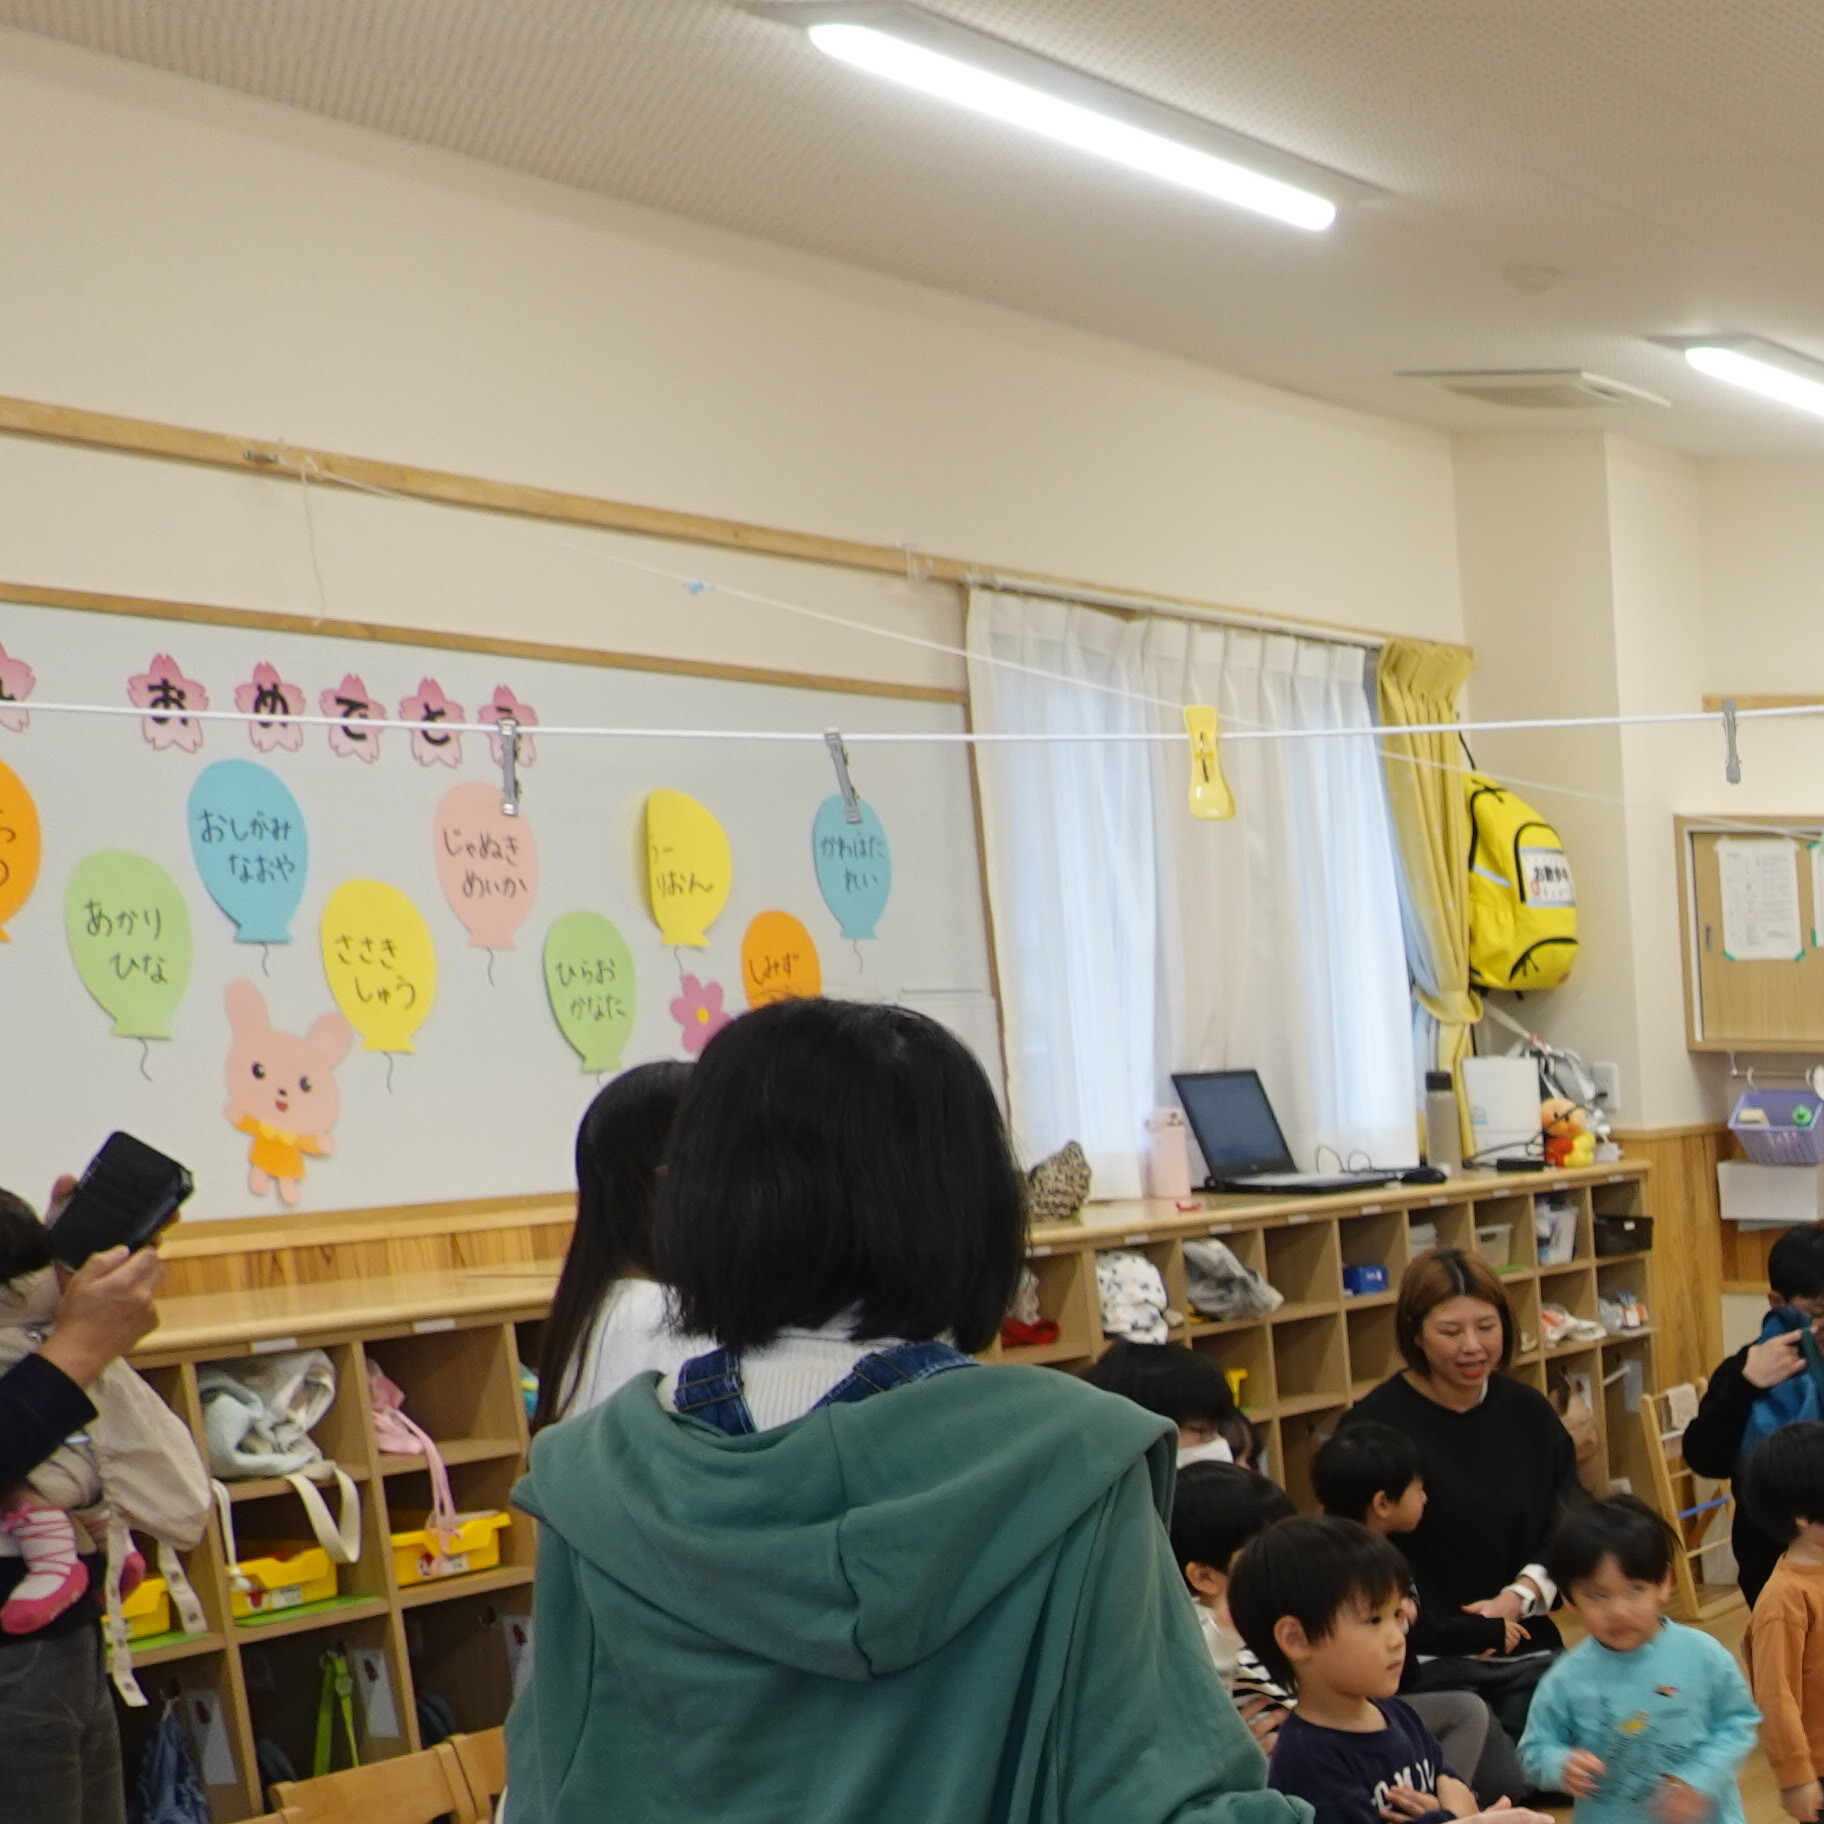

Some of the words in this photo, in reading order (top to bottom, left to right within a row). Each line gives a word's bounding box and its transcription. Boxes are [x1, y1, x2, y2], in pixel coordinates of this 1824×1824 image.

[229, 853, 296, 885] なおや
[84, 900, 162, 939] あかり
[110, 951, 169, 984] ひな
[335, 933, 399, 970] ささき
